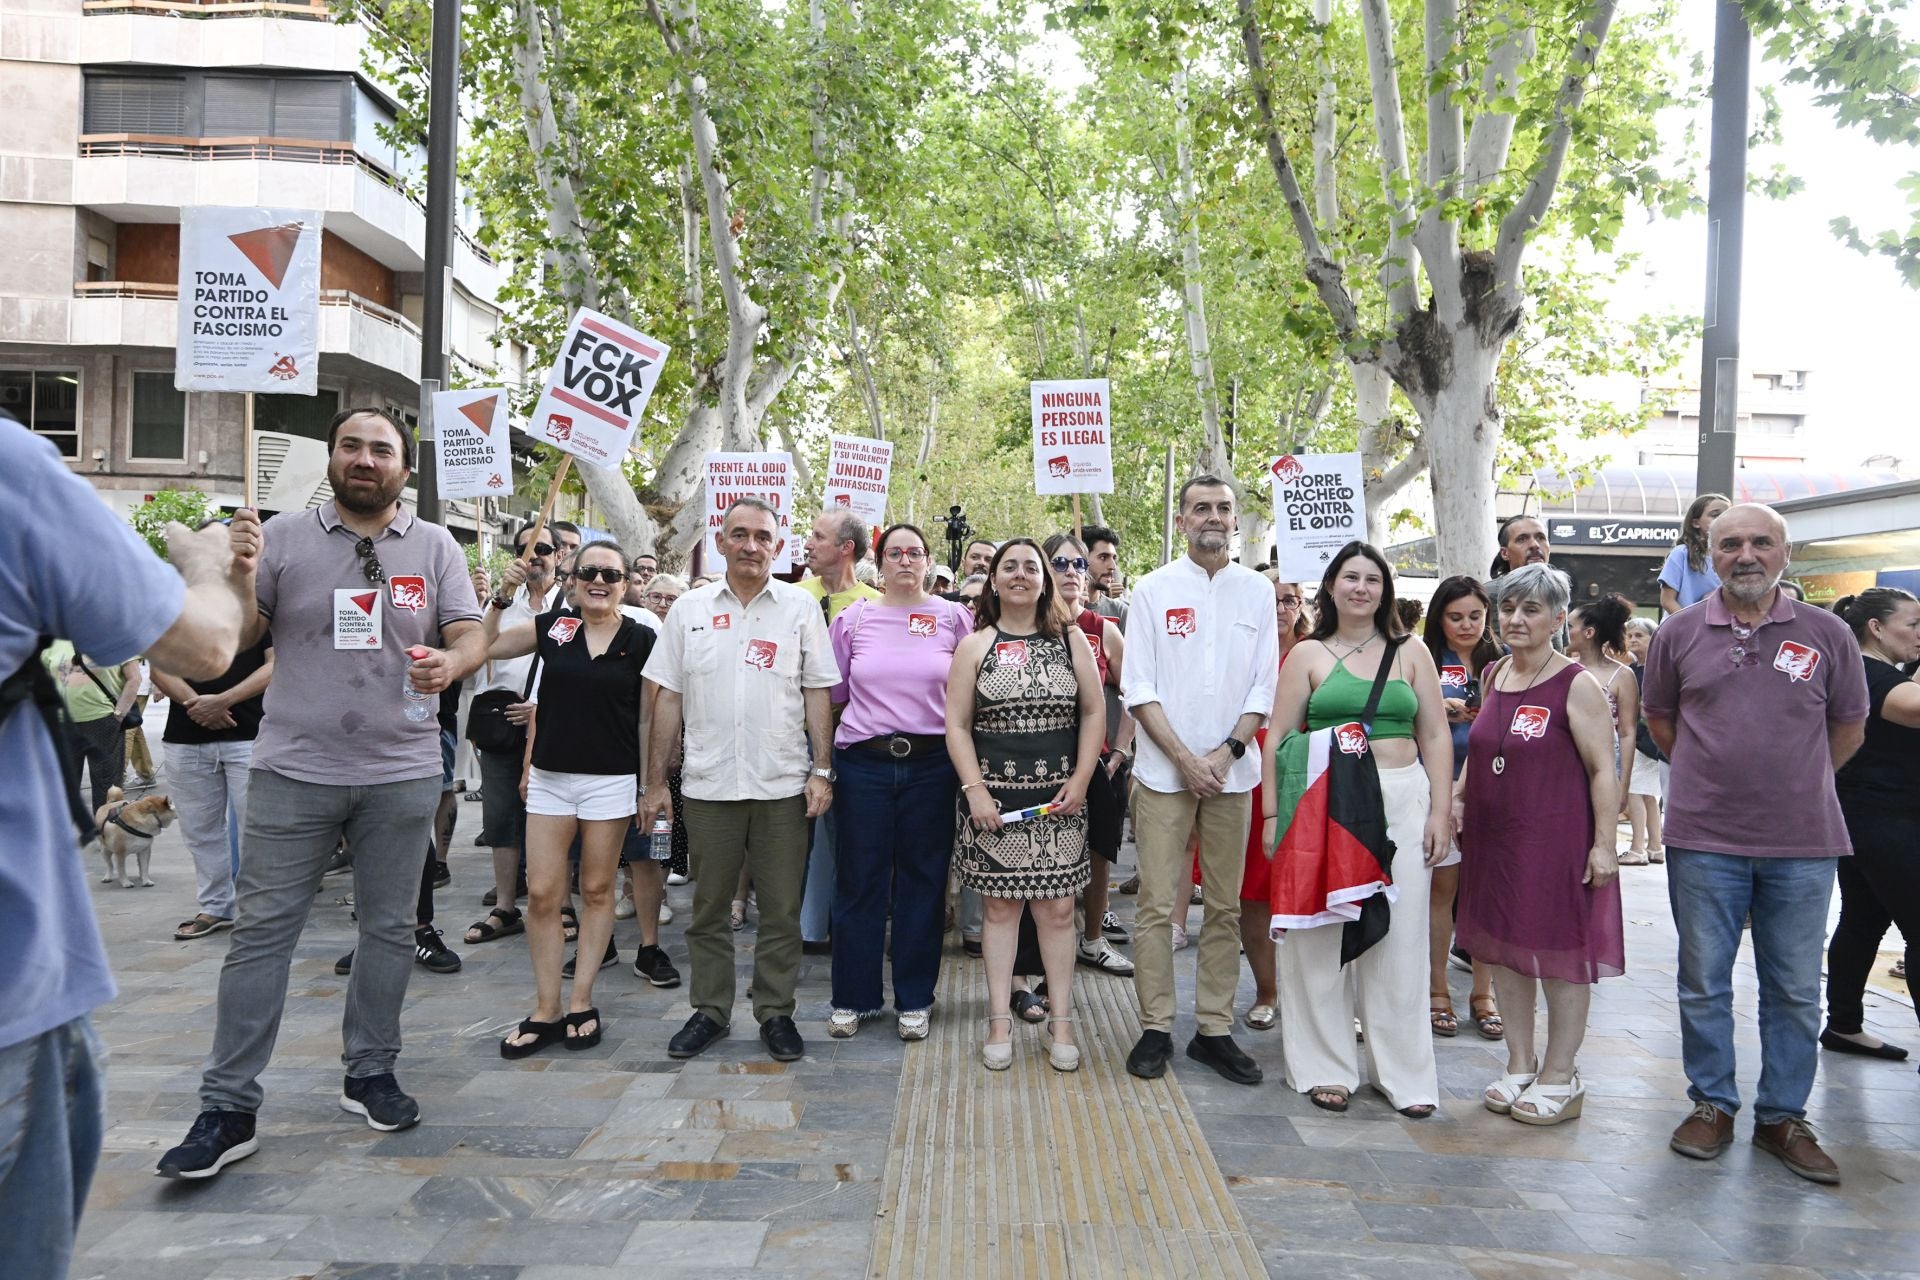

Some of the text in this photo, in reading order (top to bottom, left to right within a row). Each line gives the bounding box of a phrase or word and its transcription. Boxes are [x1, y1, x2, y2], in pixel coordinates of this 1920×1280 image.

[196, 272, 246, 286] TOMA
[194, 288, 268, 303] PARTIDO
[194, 306, 288, 320] CONTRA EL
[193, 322, 282, 336] FASCISMO
[568, 329, 653, 389] FCK
[564, 356, 642, 418] VOX
[1042, 392, 1102, 408] NINGUNA
[1042, 411, 1103, 427] PERSONA
[443, 429, 471, 438] TOMA
[1042, 430, 1105, 446] ES ILEGAL
[443, 437, 484, 447] PARTIDO
[834, 441, 859, 450] FRENTE
[872, 447, 890, 456] ODIO
[444, 448, 484, 457] CONTRA
[840, 450, 850, 459] SU
[852, 452, 887, 465] VIOLENCIA
[444, 456, 493, 467] FASCISMO
[710, 463, 786, 473] FRENTE AL ODIO
[836, 463, 882, 480] UNIDAD
[710, 476, 786, 486] Y SU VIOLENCIA
[828, 478, 886, 494] ANTIFASCISTA
[1295, 474, 1342, 488] TORRE
[1284, 487, 1354, 502] PACHECO
[1287, 501, 1354, 516] CONTRA
[1290, 517, 1306, 530] EL
[1589, 527, 1603, 539] EL
[1619, 527, 1679, 540] CAPRICHO
